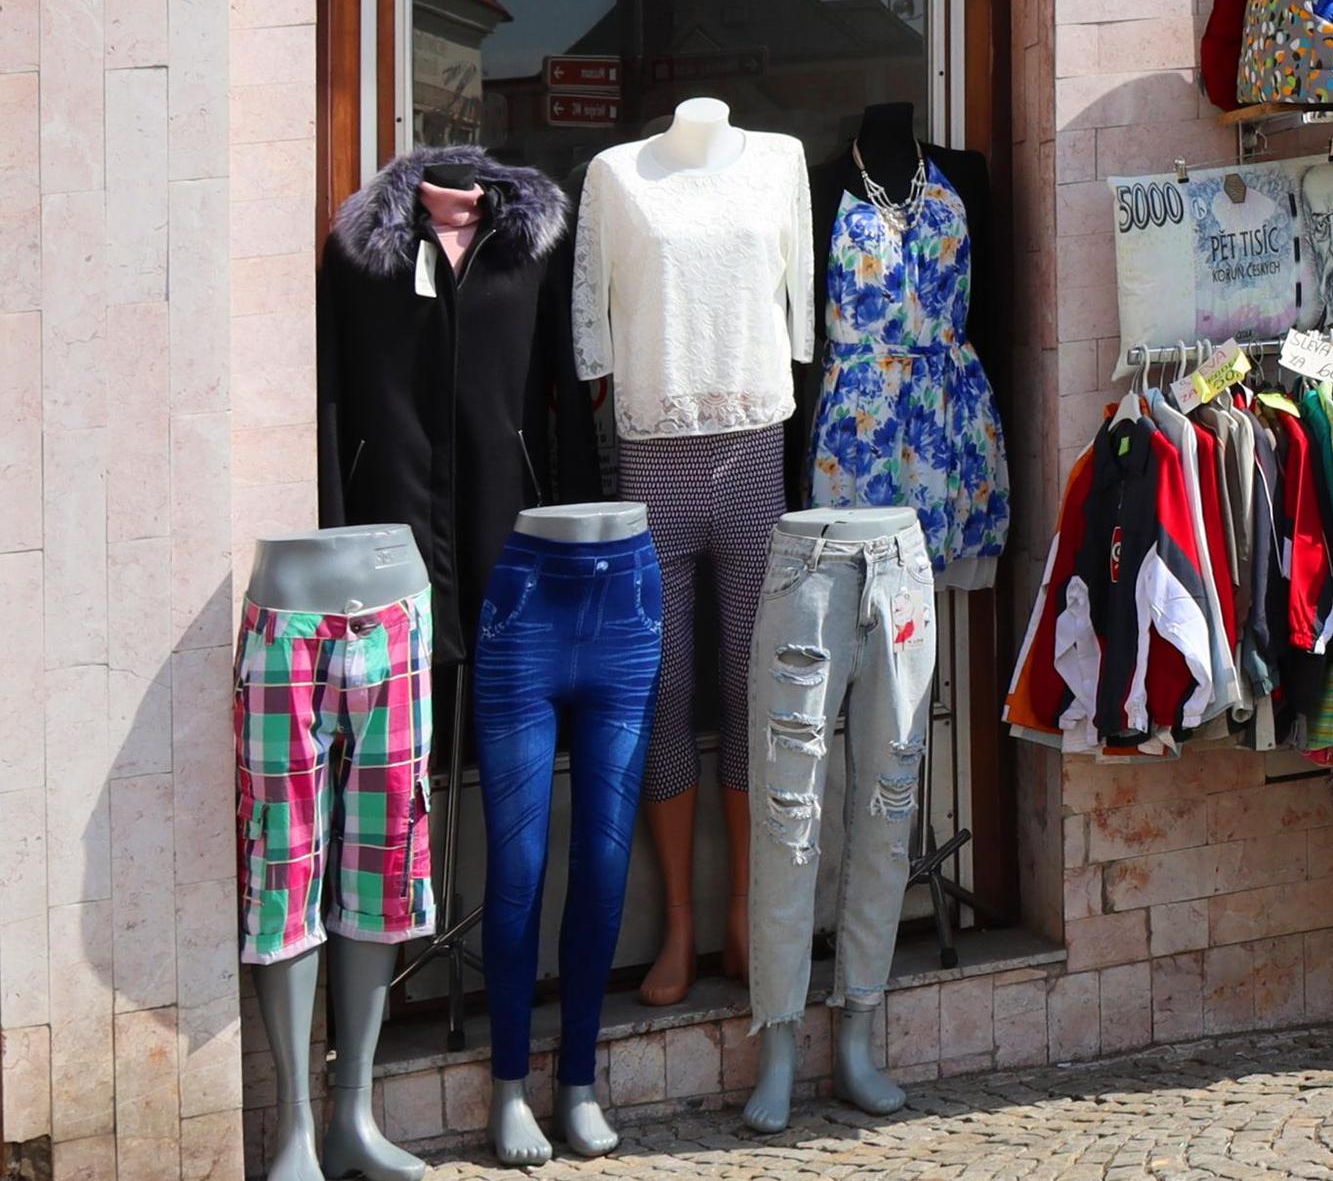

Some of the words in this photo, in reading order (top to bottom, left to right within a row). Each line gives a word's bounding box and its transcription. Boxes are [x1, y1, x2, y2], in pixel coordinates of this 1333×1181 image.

[1117, 182, 1184, 233] 5000
[1211, 231, 1237, 262] PĚT
[1240, 225, 1280, 257] TISÍC
[1289, 331, 1332, 357] SLEVA
